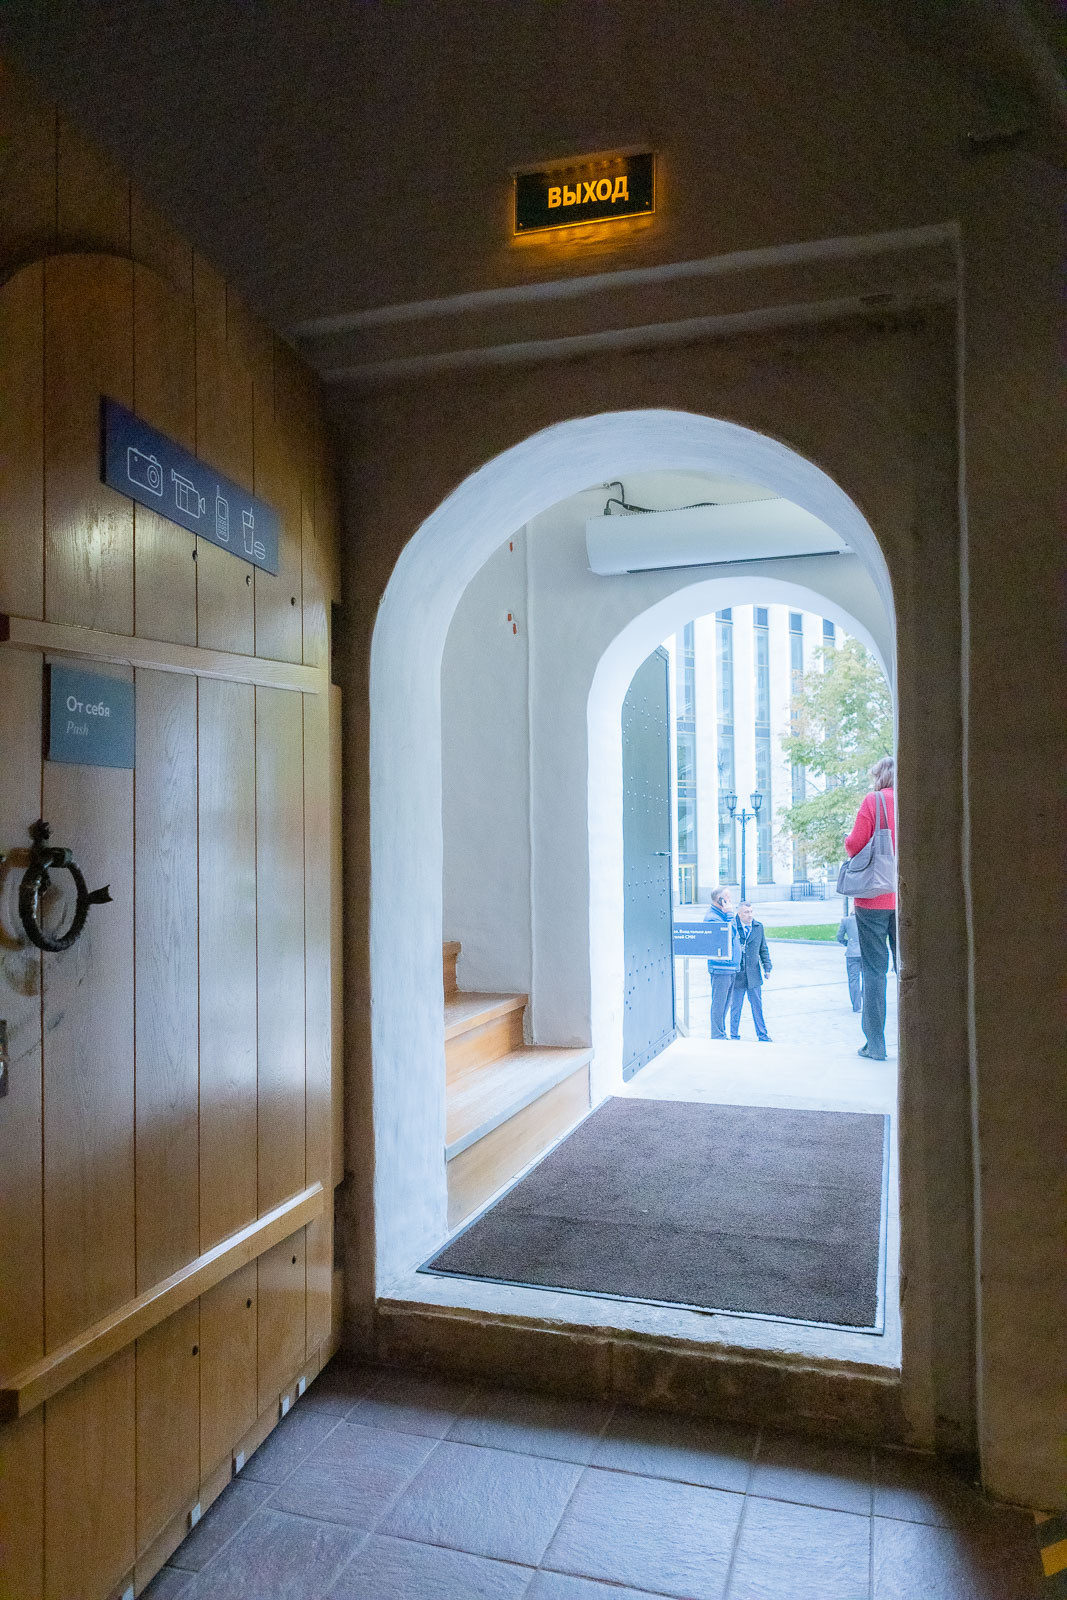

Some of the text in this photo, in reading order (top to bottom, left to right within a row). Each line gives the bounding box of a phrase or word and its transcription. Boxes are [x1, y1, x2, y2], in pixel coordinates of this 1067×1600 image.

[547, 175, 629, 209] ВЫХОД
[66, 695, 110, 718] От себя
[66, 720, 89, 736] Push
